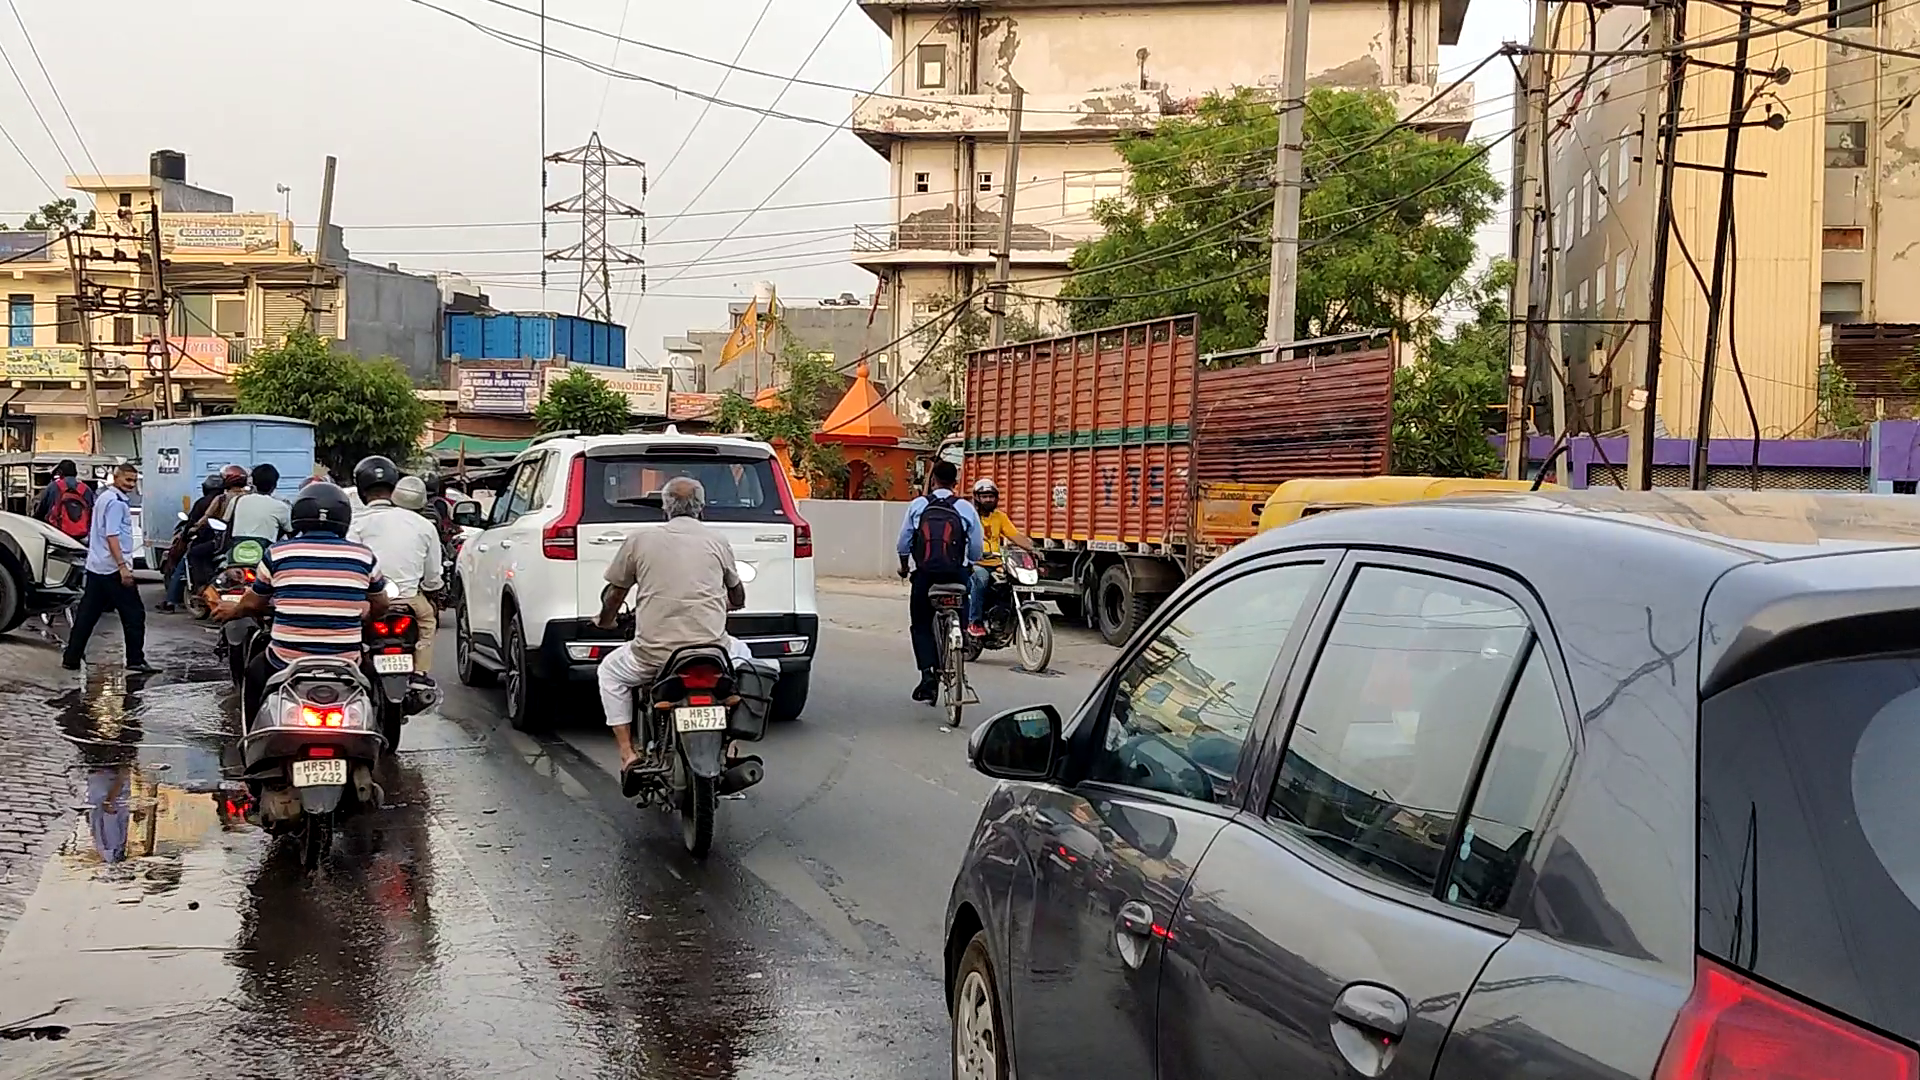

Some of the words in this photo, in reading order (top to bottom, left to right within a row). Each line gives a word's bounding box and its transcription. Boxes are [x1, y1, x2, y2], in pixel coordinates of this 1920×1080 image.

[187, 343, 223, 352] TYRES
[511, 379, 538, 387] MOTORS
[609, 380, 662, 392] OMOBILES
[690, 708, 716, 718] HR51
[683, 717, 725, 730] BN4774
[303, 761, 341, 772] HR51B
[305, 772, 342, 784] Y3432
